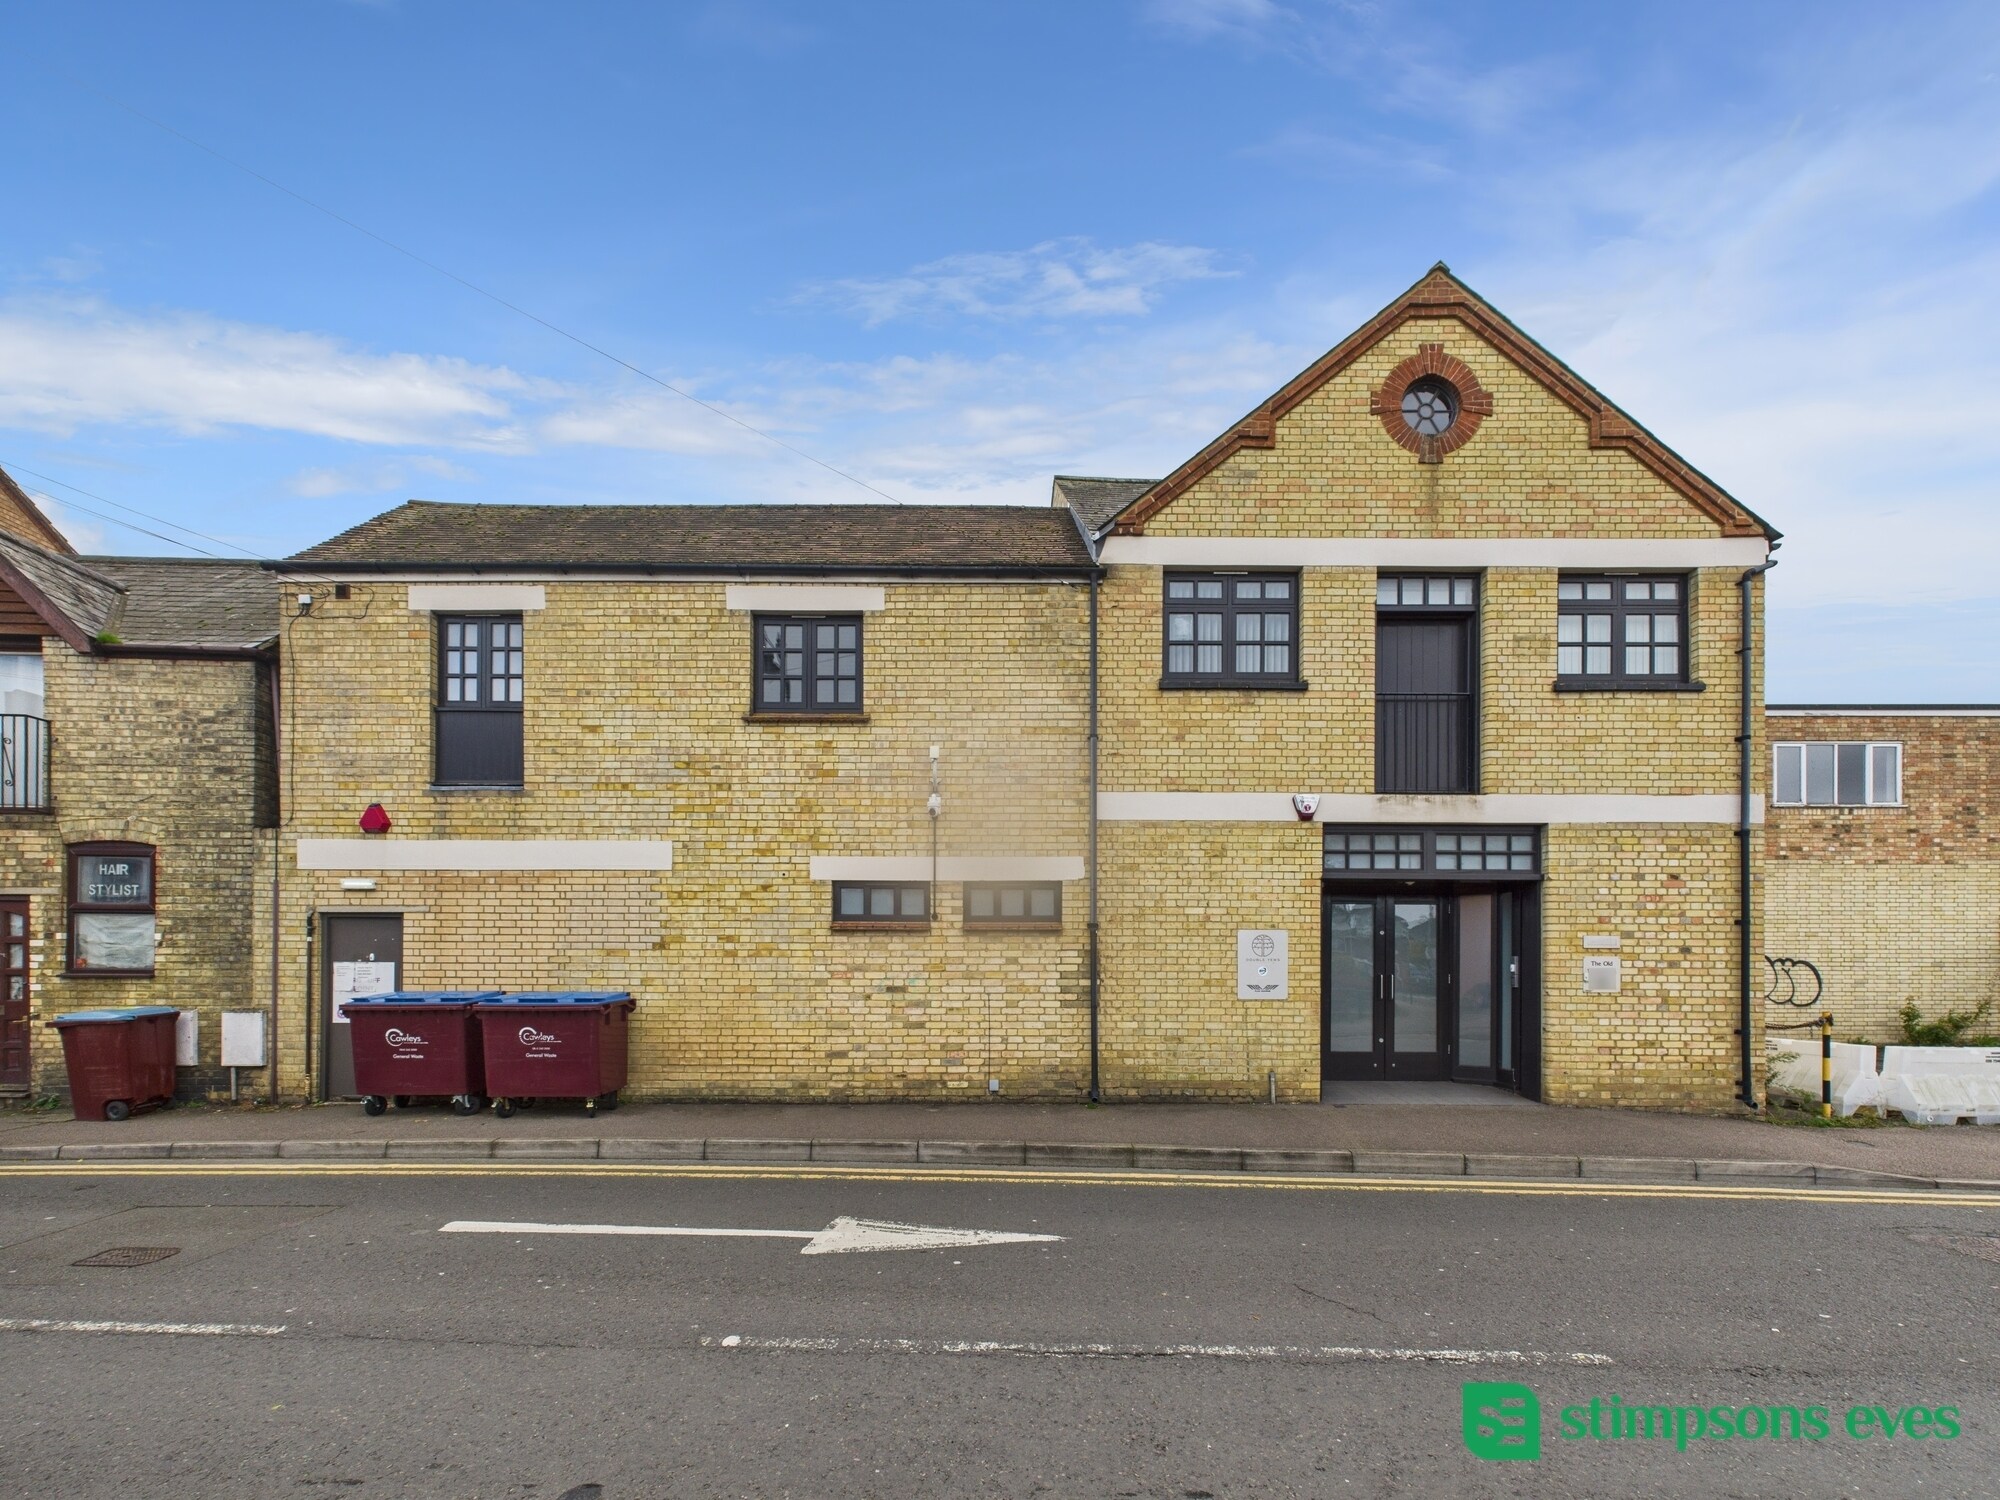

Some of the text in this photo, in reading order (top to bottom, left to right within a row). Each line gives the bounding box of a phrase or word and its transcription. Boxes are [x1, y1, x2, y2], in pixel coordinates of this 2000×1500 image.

[99, 864, 129, 875] HAIR
[88, 884, 139, 896] STYLIST
[390, 1033, 421, 1044] Cawleys
